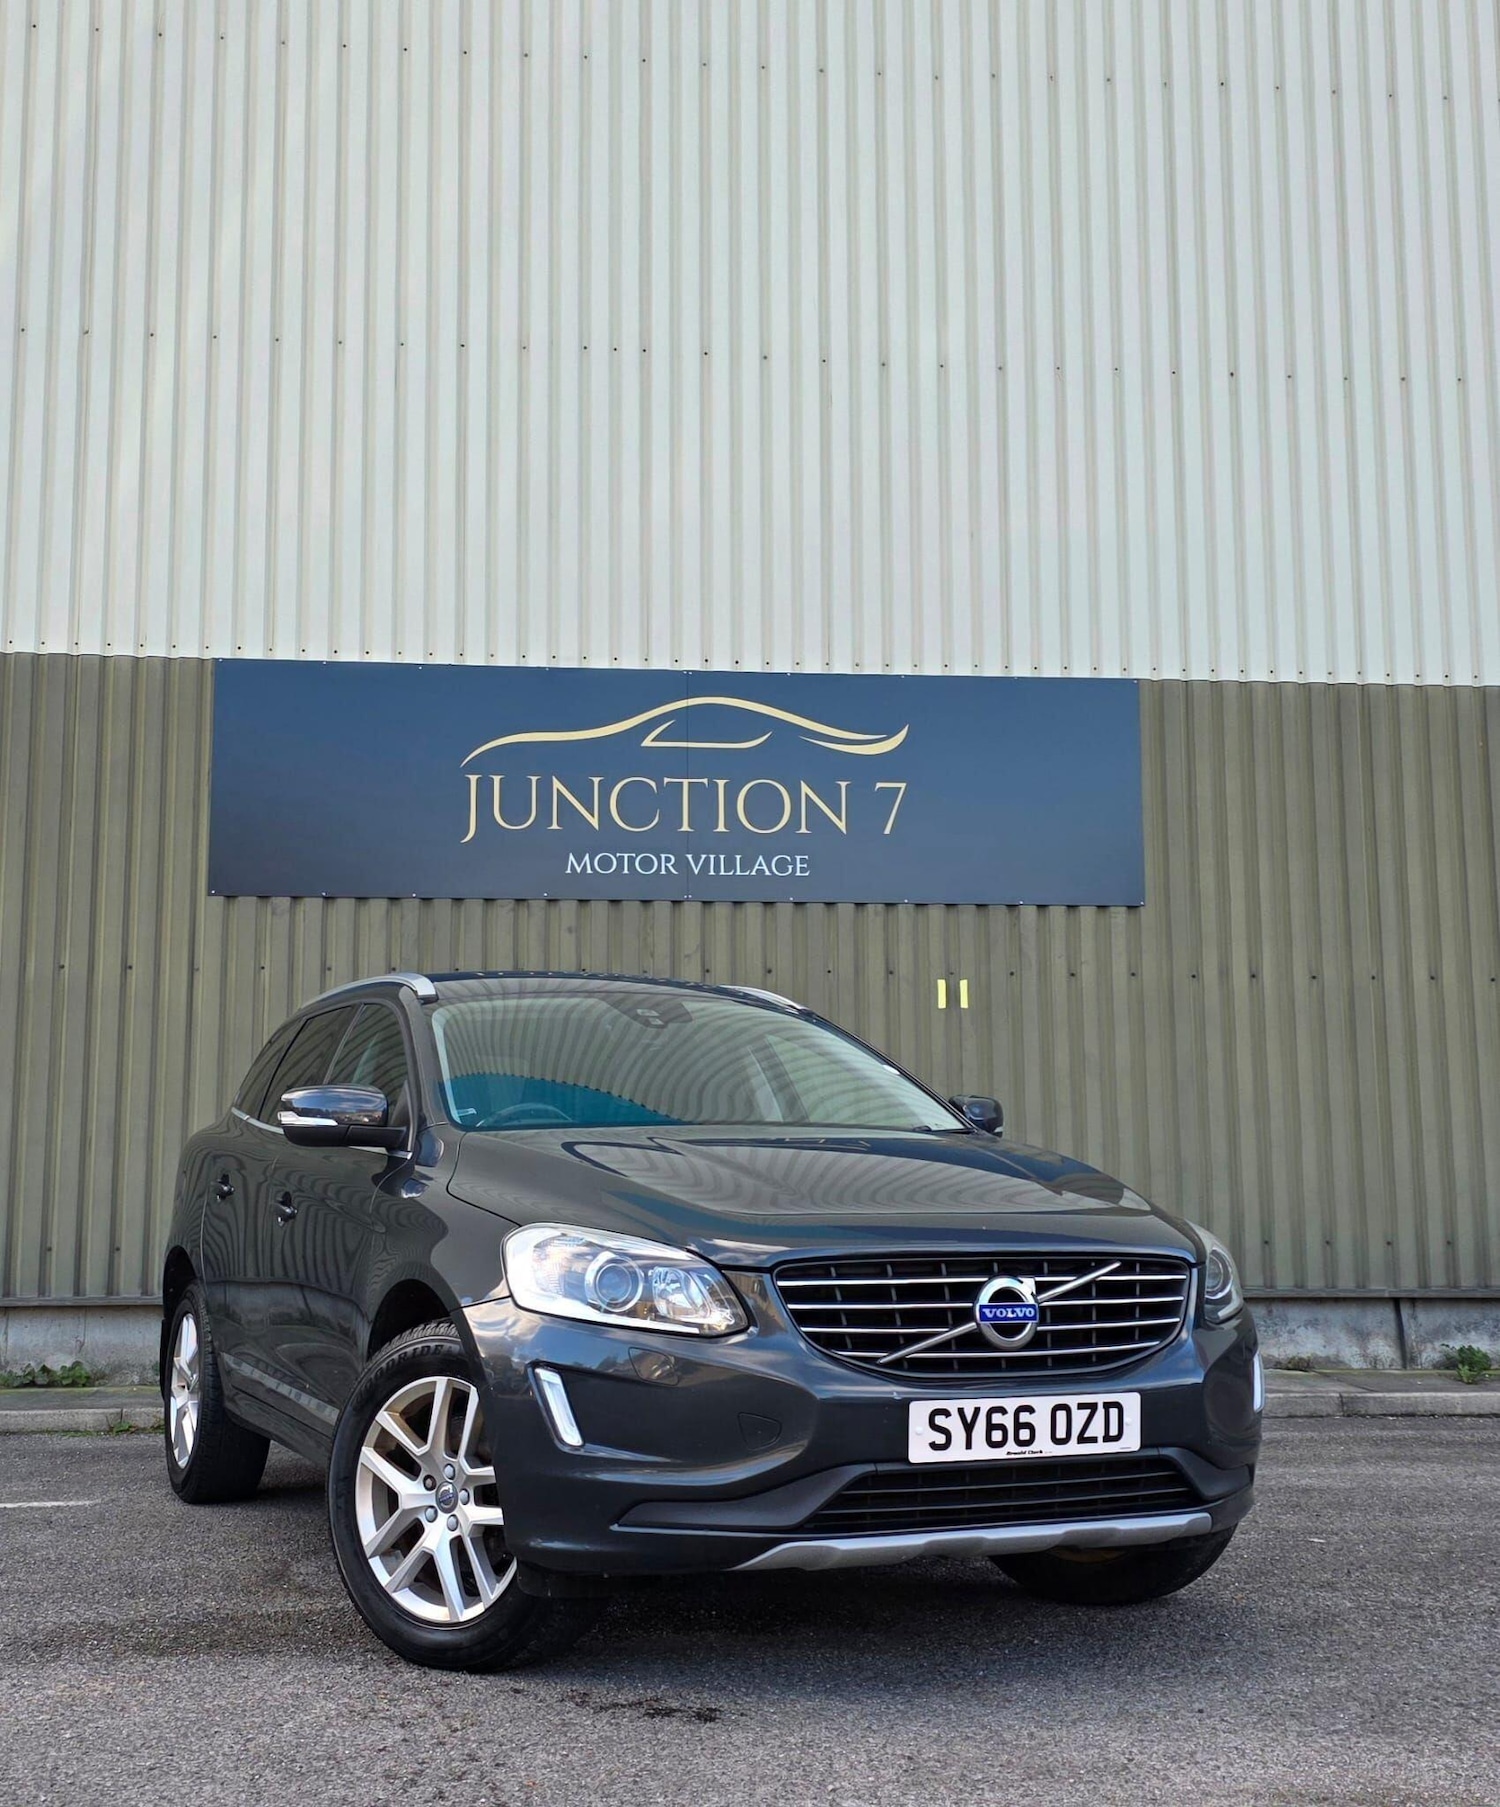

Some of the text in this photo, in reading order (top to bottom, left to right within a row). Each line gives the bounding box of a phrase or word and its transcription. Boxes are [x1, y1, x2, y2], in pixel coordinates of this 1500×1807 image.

[460, 774, 908, 844] JUNCTION 7
[565, 852, 811, 877] MOTOR VILLAGE
[982, 1307, 1035, 1318] VOLVO
[928, 1401, 1124, 1451] SY66 OZD
